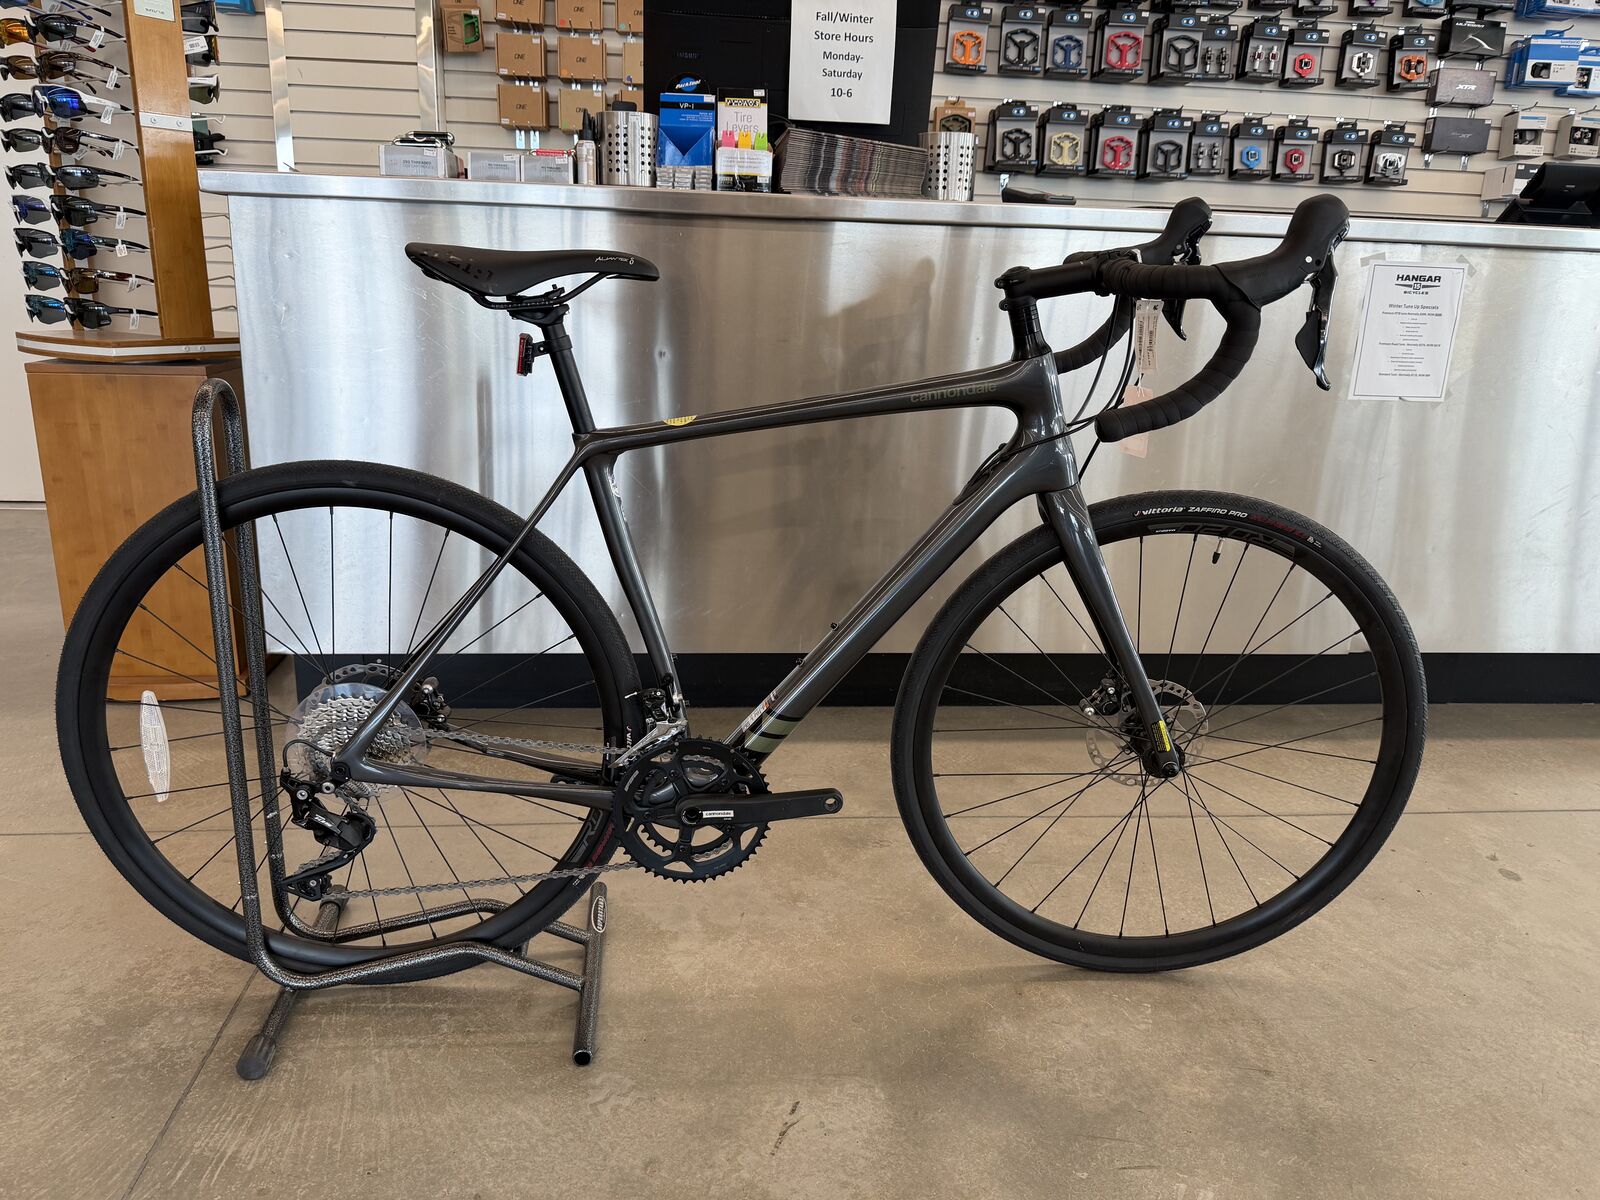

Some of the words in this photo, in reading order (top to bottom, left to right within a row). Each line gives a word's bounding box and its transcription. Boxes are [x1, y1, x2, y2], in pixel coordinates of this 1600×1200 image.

[815, 11, 874, 24] Fall/Winter
[814, 31, 841, 41] Store
[844, 32, 874, 43] Hours
[822, 51, 864, 63] Monday-
[822, 68, 863, 80] Saturday
[830, 87, 853, 98] 10-6
[734, 112, 753, 123] Tire
[726, 121, 759, 133] Levers
[1396, 274, 1441, 282] HANGAR
[910, 382, 997, 402] cannondale
[1142, 506, 1184, 515] vittoria
